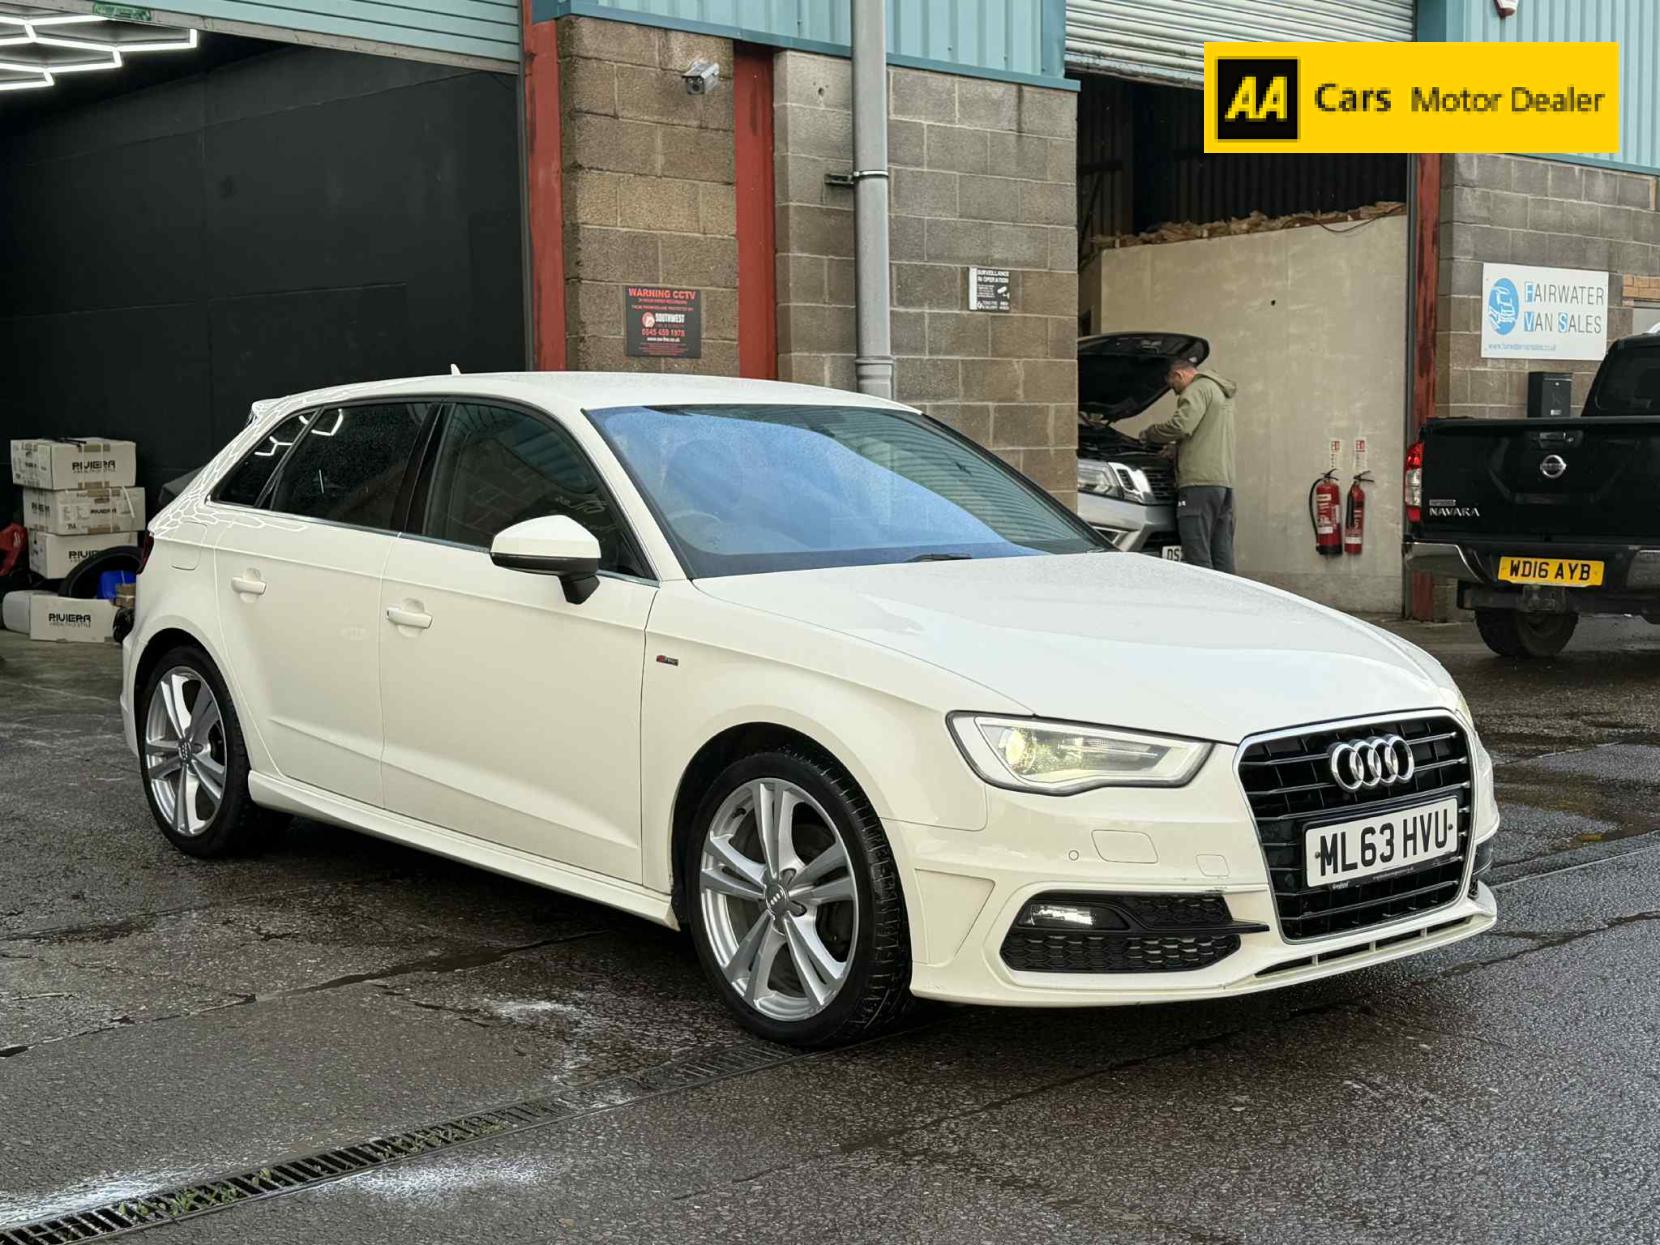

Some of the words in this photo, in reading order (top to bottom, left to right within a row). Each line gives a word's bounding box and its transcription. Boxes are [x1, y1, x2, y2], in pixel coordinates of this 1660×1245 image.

[628, 287, 671, 299] WARNING
[672, 290, 696, 300] CCTV
[1525, 282, 1604, 305] FAIRWATER
[1524, 312, 1553, 333] VAN
[1558, 312, 1602, 334] SALES
[1429, 507, 1480, 517] NAVARA
[1510, 560, 1549, 579] WD16
[1555, 563, 1591, 581] AYB
[48, 613, 92, 623] RIVIERA
[1320, 822, 1395, 877] ML63
[1403, 809, 1448, 859] HVU
